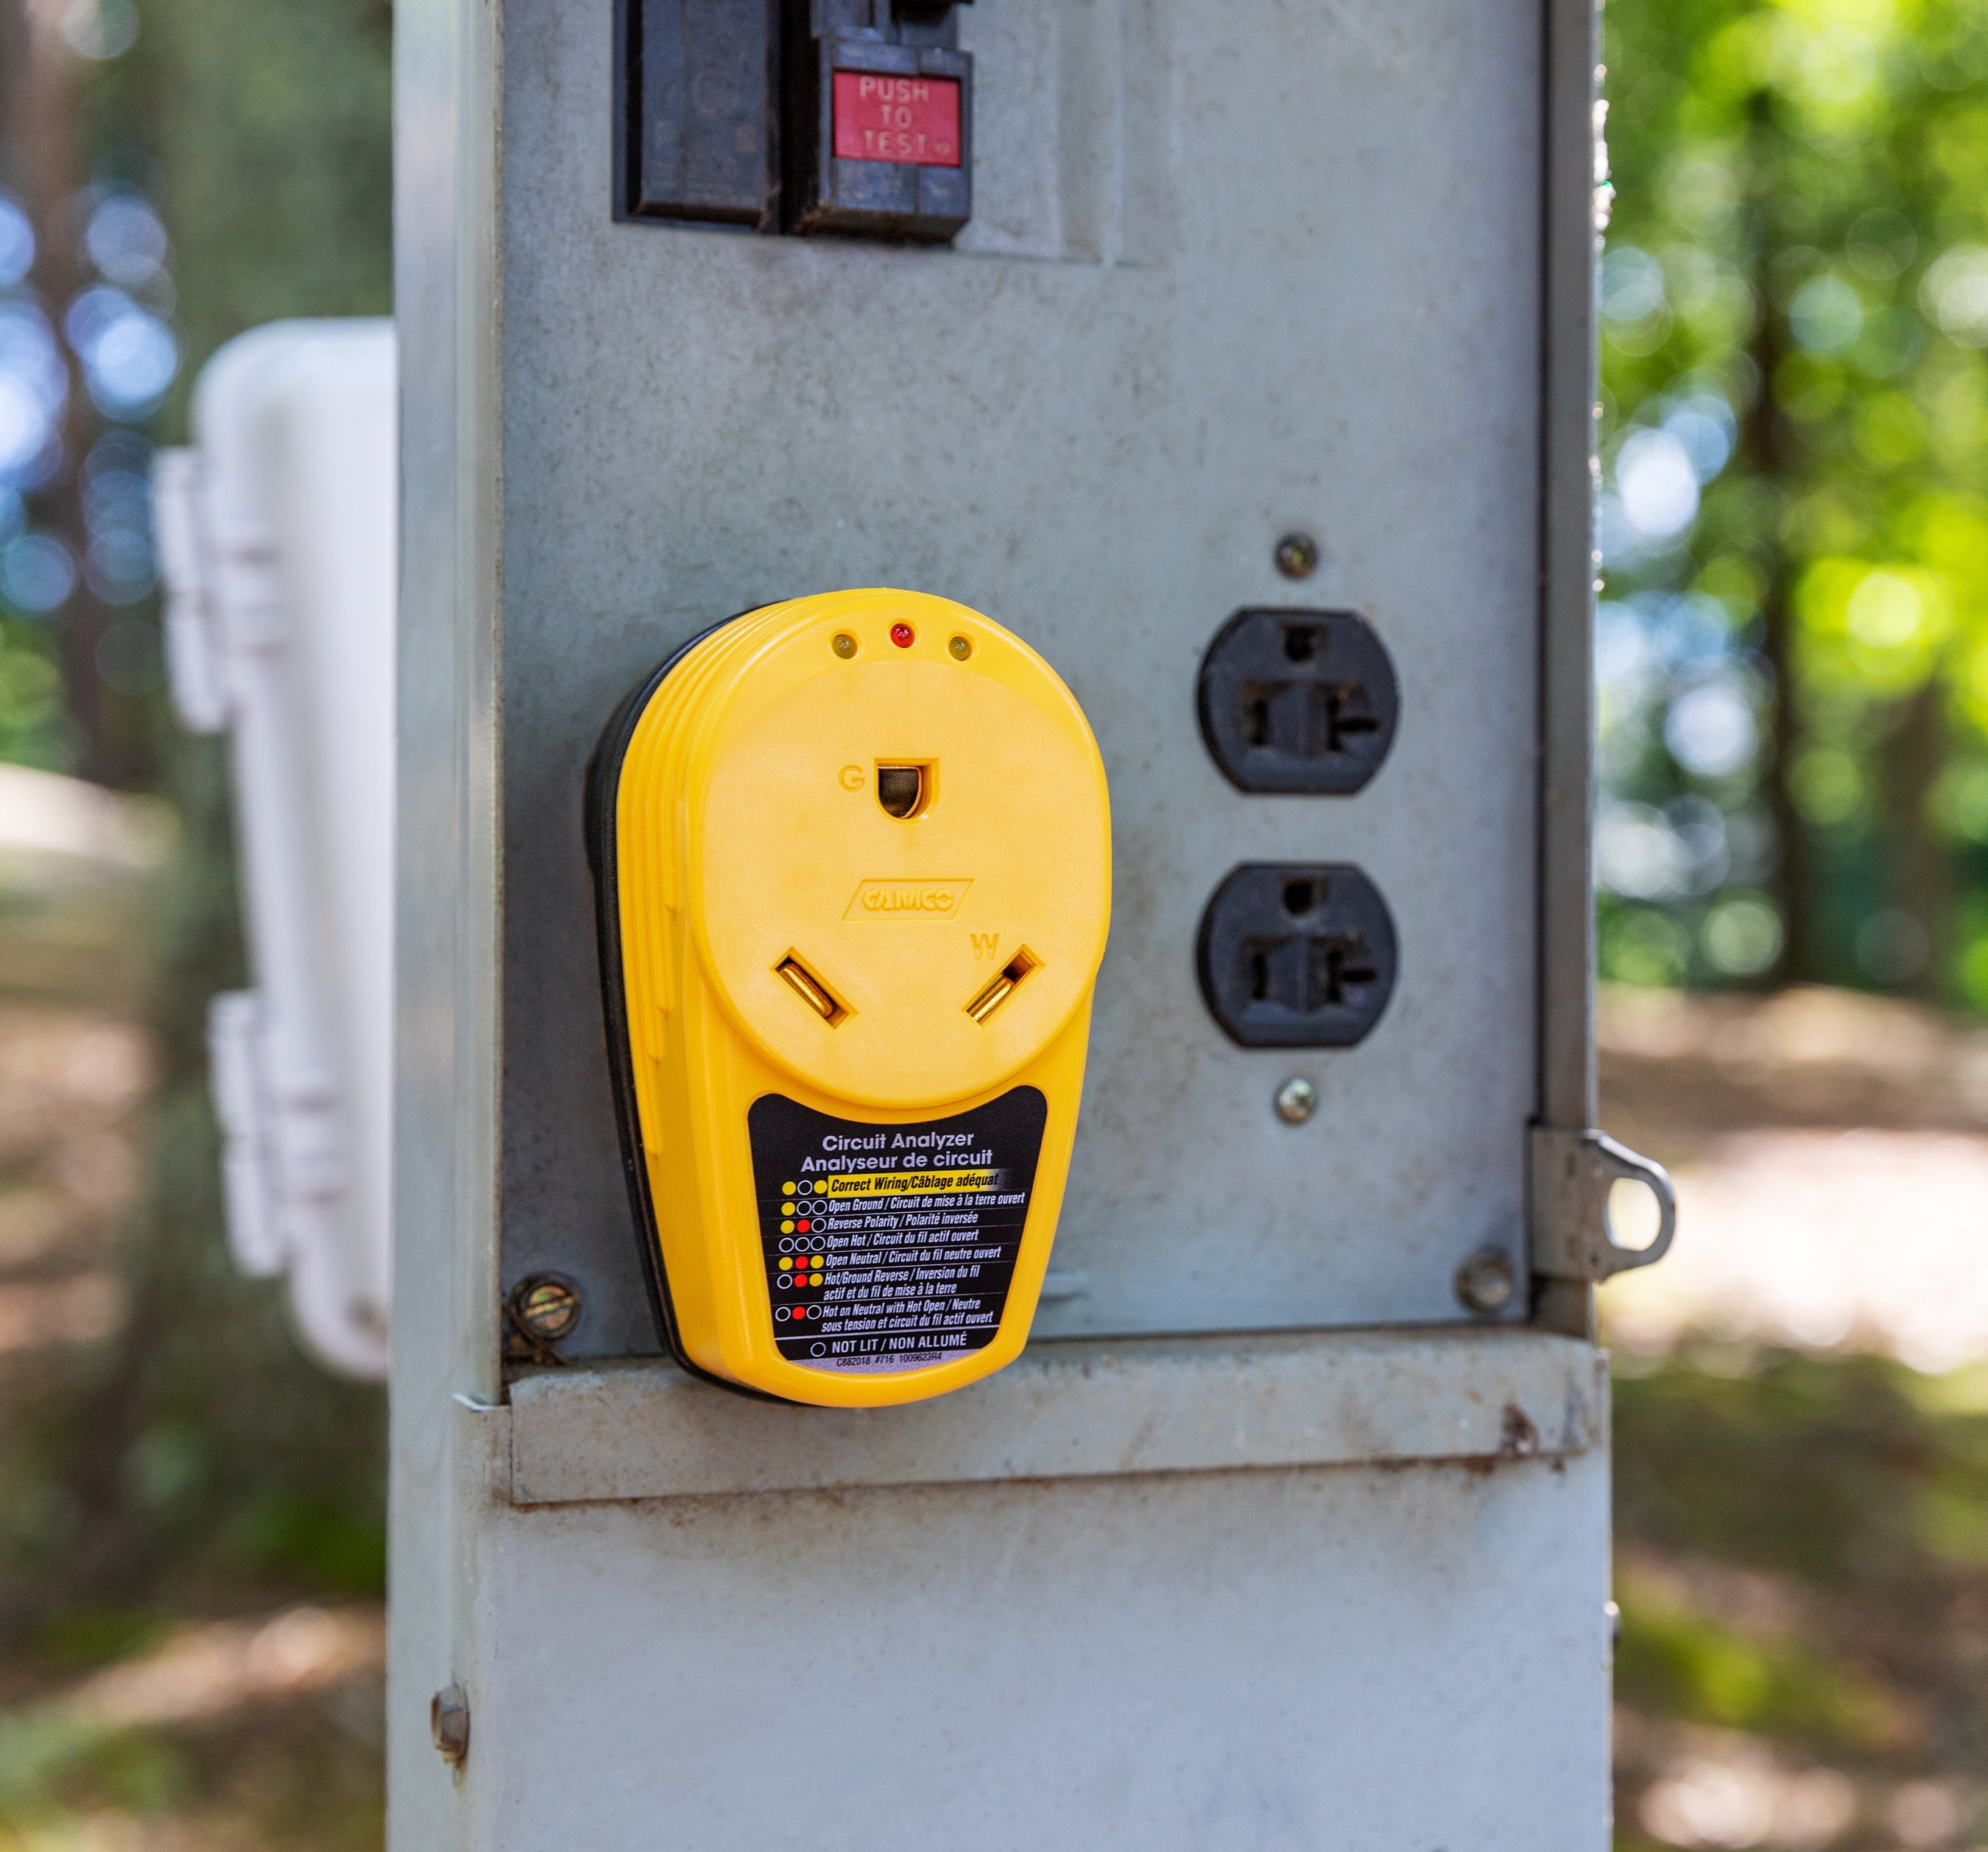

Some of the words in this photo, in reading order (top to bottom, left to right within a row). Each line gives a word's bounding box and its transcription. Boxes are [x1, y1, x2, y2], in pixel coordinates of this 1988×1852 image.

[859, 76, 929, 103] PUSH
[881, 105, 912, 129] TO
[864, 130, 926, 158] TEST
[838, 764, 865, 793] G
[861, 889, 954, 912] CAMCO
[970, 933, 1000, 961] W
[822, 1133, 887, 1151] Circuit
[890, 1132, 974, 1150] Analyzer
[800, 1155, 898, 1173] Analyseur
[903, 1152, 928, 1168] de
[933, 1149, 993, 1166] circuit
[831, 1178, 871, 1192] Correct
[874, 1175, 954, 1192] Wiring/Câblage
[956, 1173, 998, 1189] adéquat
[828, 1200, 850, 1214] Open
[852, 1197, 884, 1211] Ground
[890, 1196, 920, 1209] Circuit
[921, 1196, 933, 1208] de
[934, 1195, 955, 1207] mise
[956, 1194, 963, 1206] à
[964, 1194, 973, 1206] la
[975, 1193, 996, 1205] terre
[997, 1191, 1026, 1204] ouvert
[827, 1218, 863, 1230] Reverse
[864, 1215, 899, 1229] Polarity
[905, 1212, 940, 1226] Polarité
[941, 1211, 979, 1224] inversée
[827, 1236, 849, 1250] Open
[850, 1234, 867, 1247] Hot
[873, 1233, 903, 1245] Circuit
[904, 1232, 916, 1244] du
[917, 1231, 928, 1243] fil
[928, 1230, 951, 1243] actif
[951, 1229, 979, 1242] ouvert
[825, 1254, 848, 1268] Open
[849, 1252, 882, 1265] Neutral
[888, 1250, 918, 1263] Circuit
[920, 1250, 931, 1261] du
[932, 1249, 943, 1261] fil
[943, 1248, 972, 1260] neutre
[973, 1246, 1001, 1258] ouvert
[824, 1270, 873, 1285] Hot/Ground
[874, 1270, 909, 1282] Reverse
[915, 1267, 956, 1280] Inversion
[957, 1266, 968, 1278] du
[970, 1265, 980, 1278] fil
[823, 1286, 846, 1300] actif
[846, 1286, 856, 1299] et
[858, 1286, 869, 1298] du
[870, 1285, 881, 1298] fil
[882, 1284, 894, 1297] de
[895, 1284, 916, 1296] mise
[917, 1283, 923, 1295] à
[925, 1282, 934, 1295] la
[936, 1282, 957, 1294] terre
[822, 1306, 839, 1317] Hot
[840, 1307, 851, 1317] on
[852, 1303, 885, 1315] Neutral
[886, 1301, 906, 1313] with
[906, 1300, 923, 1312] Hot
[923, 1300, 945, 1314] Open
[952, 1298, 981, 1310] Neutre
[821, 1322, 842, 1332] sous
[844, 1317, 876, 1331] tension
[878, 1317, 888, 1329] et
[889, 1314, 918, 1328] circuit
[919, 1314, 931, 1326] du
[931, 1313, 942, 1325] fil
[943, 1312, 965, 1325] actif
[965, 1311, 993, 1324] ouvert
[832, 1341, 857, 1353] NOT
[860, 1339, 878, 1352] LIT
[889, 1337, 914, 1350] NON
[917, 1331, 967, 1348] ALLUMÉ
[836, 1356, 871, 1367] C882018
[875, 1354, 895, 1364] #716
